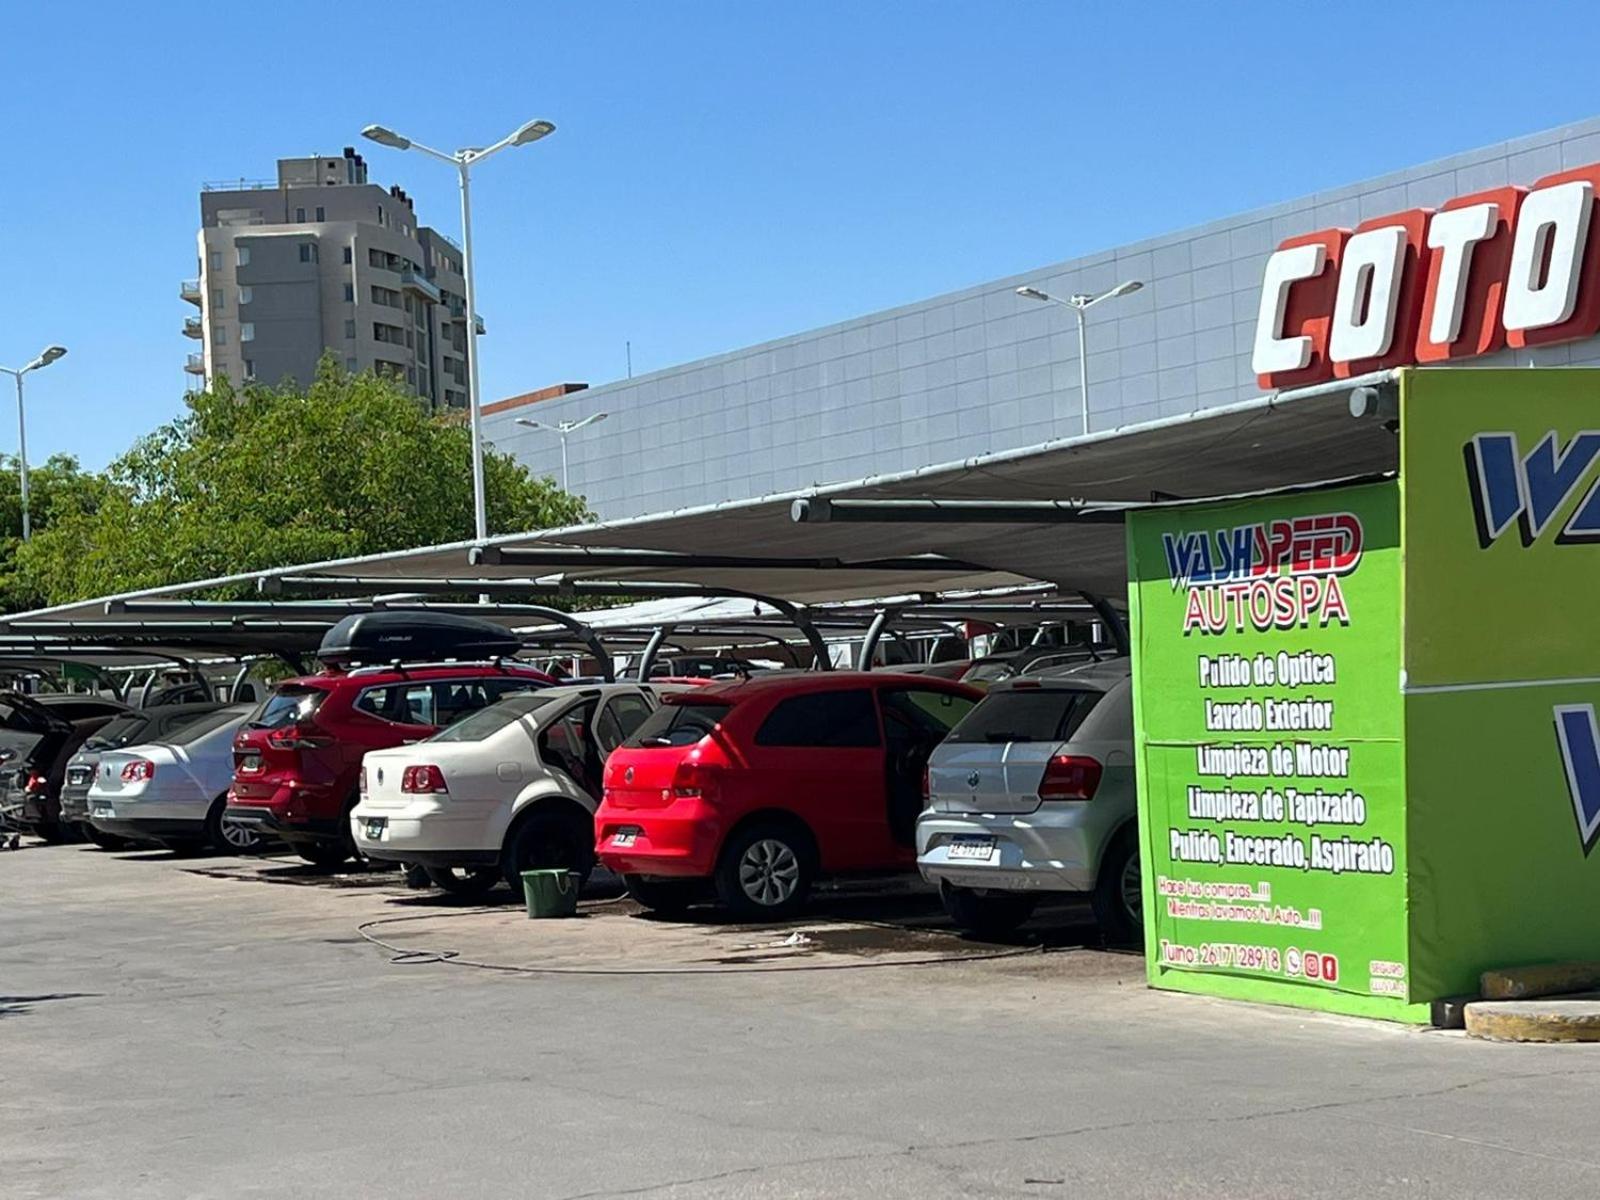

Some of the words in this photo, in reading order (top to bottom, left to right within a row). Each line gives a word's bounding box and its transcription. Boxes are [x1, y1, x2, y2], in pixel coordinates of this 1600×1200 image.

[1252, 180, 1594, 375] COTO
[1183, 575, 1349, 635] AUTOSPA
[1199, 655, 1248, 687] Pulido
[1252, 654, 1275, 687] de
[1277, 651, 1336, 690] Optica
[1205, 699, 1263, 732] Lavado
[1265, 697, 1334, 732] Exterior
[1197, 744, 1268, 779] Limpieza
[1271, 745, 1294, 776] de
[1296, 743, 1349, 778] Motor
[1187, 785, 1259, 822] Limpieza
[1261, 787, 1284, 822] de
[1285, 787, 1366, 826] Tapizado
[1169, 828, 1224, 865] Pulido,
[1224, 830, 1310, 871] Encerado,
[1311, 836, 1394, 874] Aspirado
